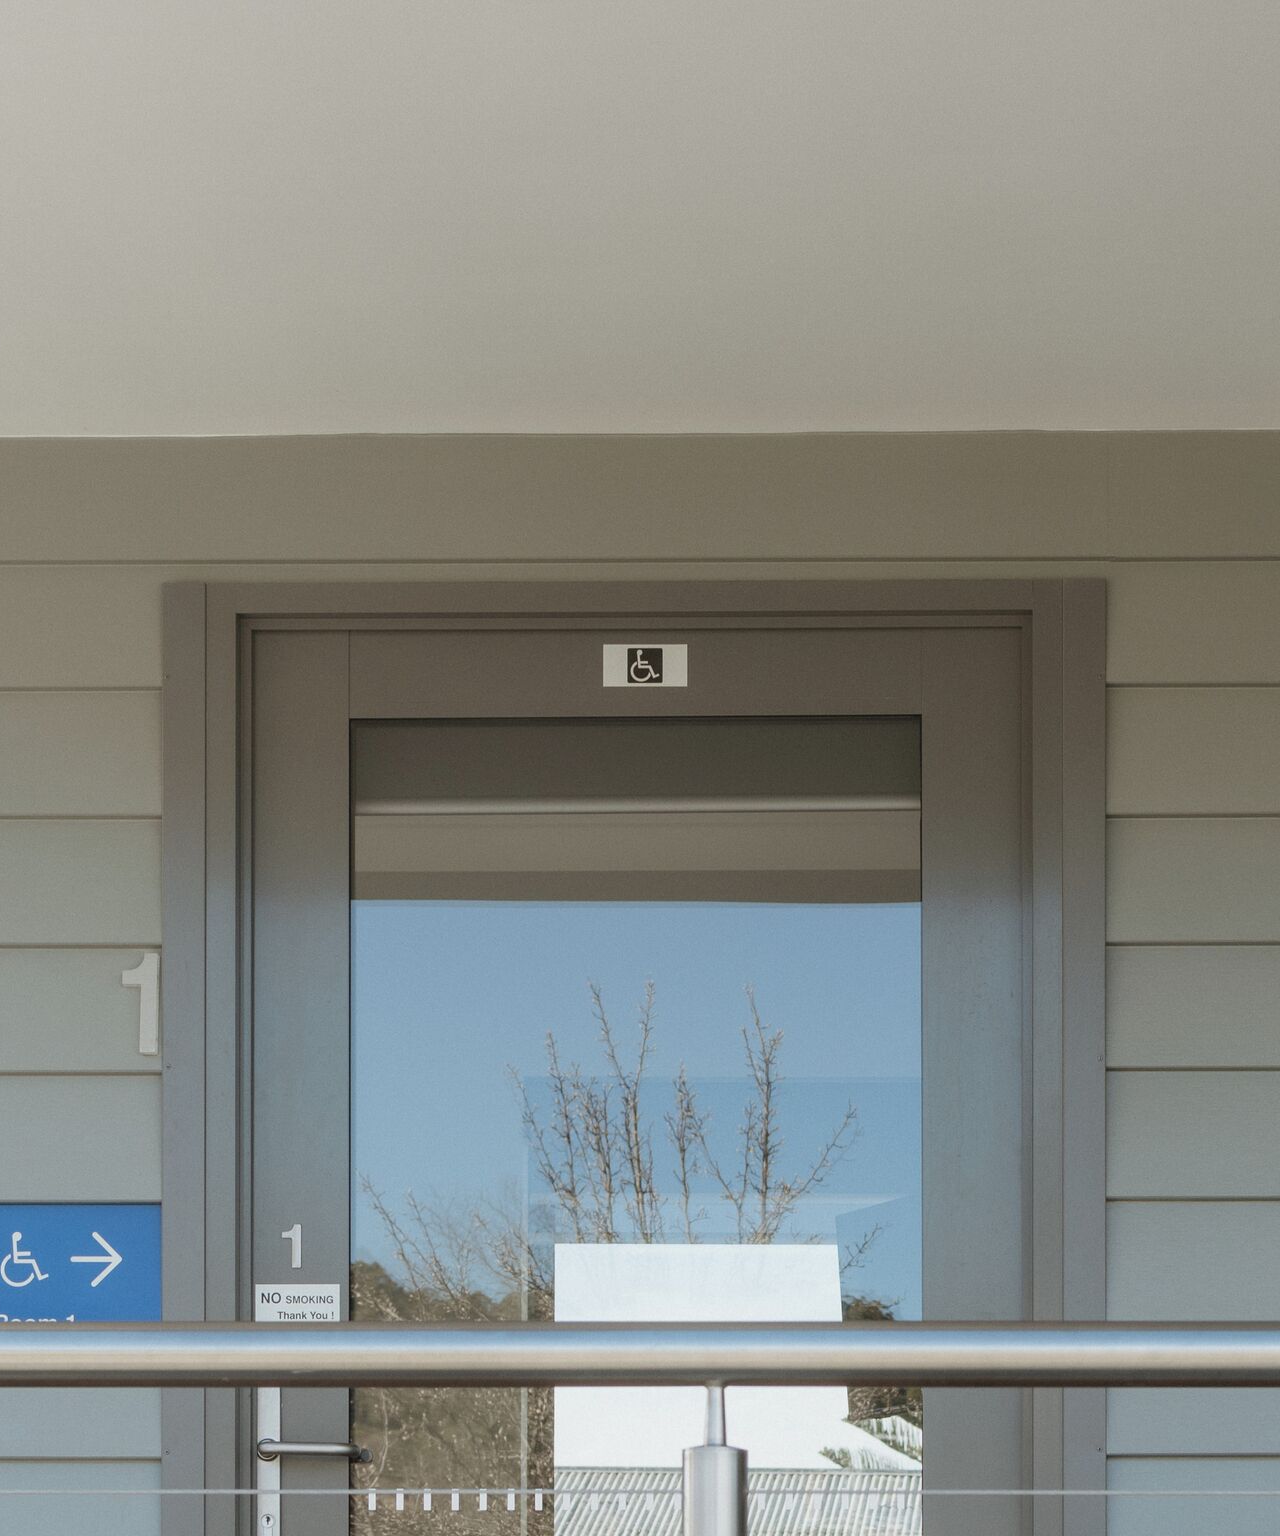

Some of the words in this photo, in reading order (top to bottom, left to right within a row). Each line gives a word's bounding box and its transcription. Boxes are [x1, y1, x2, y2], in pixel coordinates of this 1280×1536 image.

[121, 952, 160, 1056] 1
[281, 1223, 302, 1269] 1
[261, 1292, 282, 1304] NO
[285, 1295, 334, 1304] SMOKING
[277, 1311, 307, 1320] Thank
[310, 1311, 328, 1320] You
